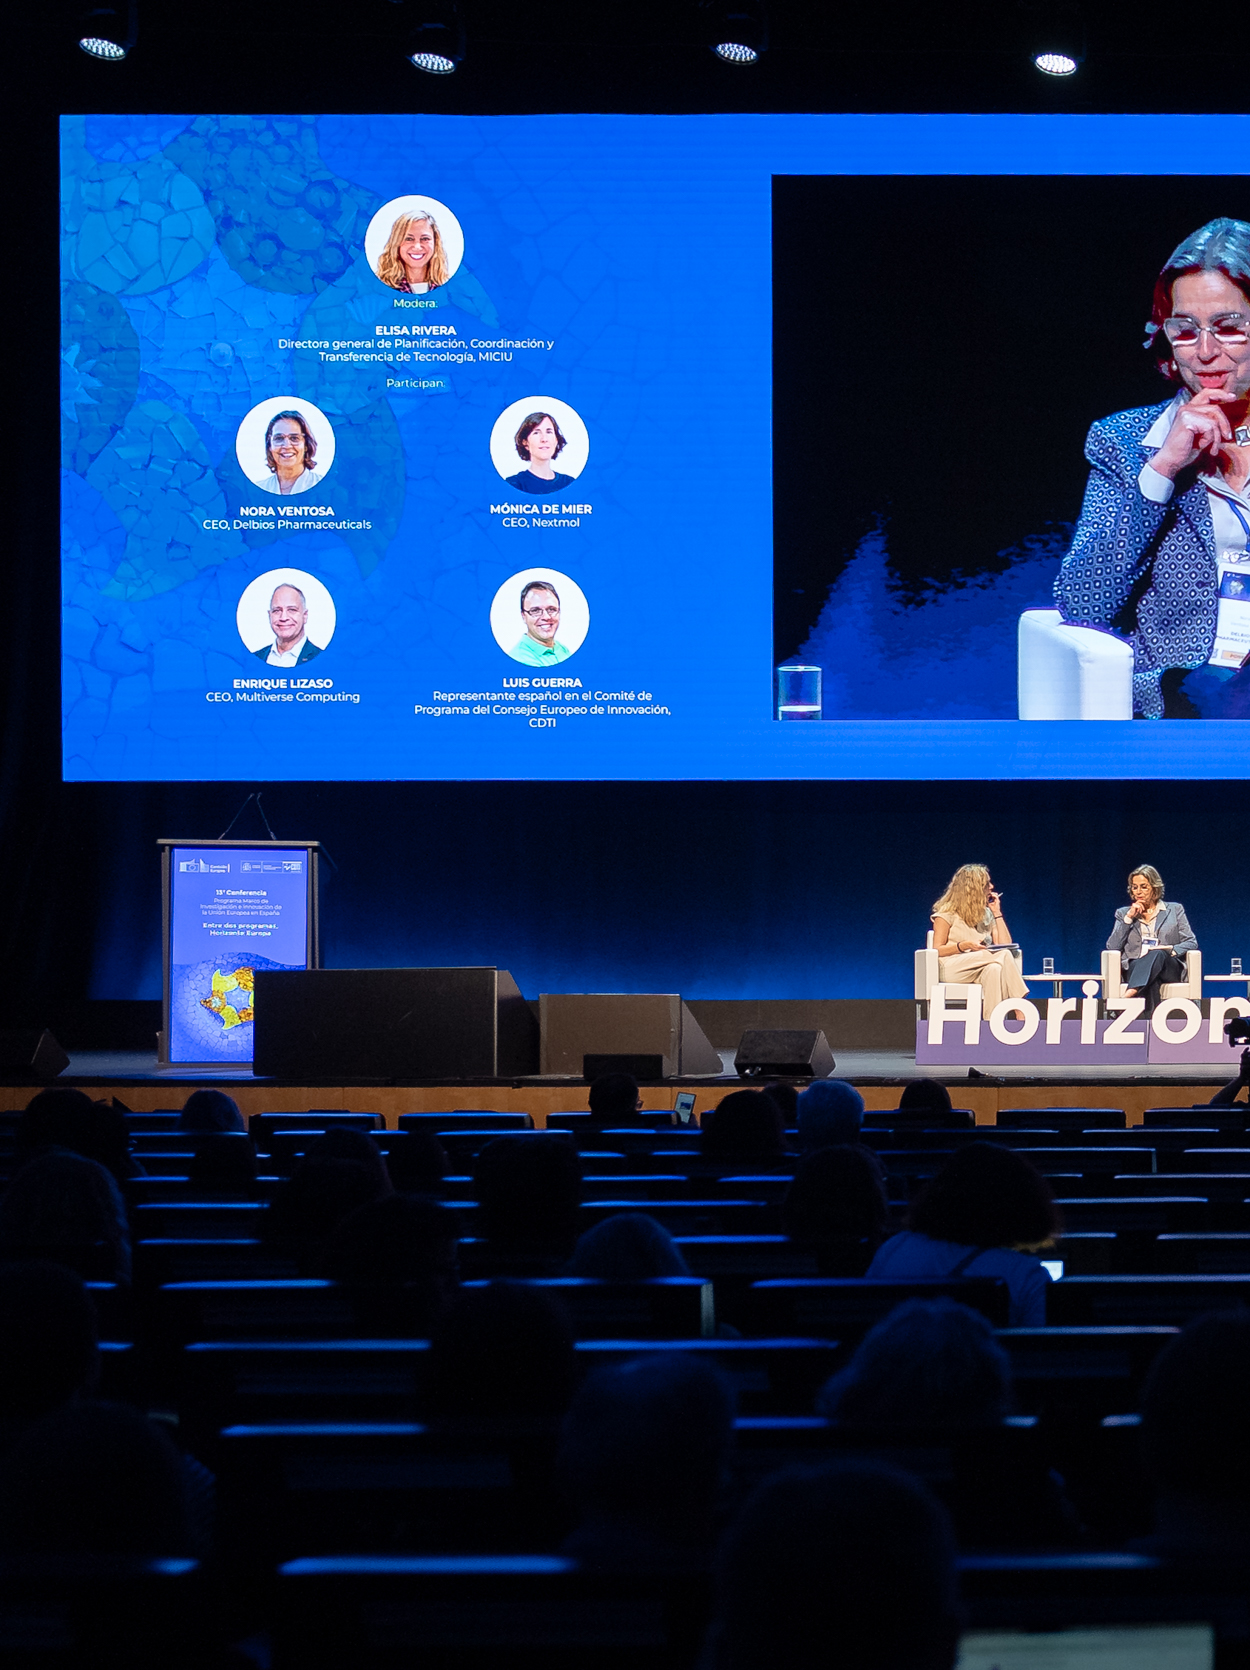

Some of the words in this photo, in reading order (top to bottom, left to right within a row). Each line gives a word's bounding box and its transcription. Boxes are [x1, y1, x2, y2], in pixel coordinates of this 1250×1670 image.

[393, 298, 438, 308] Modera:
[375, 325, 410, 336] ELISA
[411, 325, 457, 336] RIVERA
[278, 338, 330, 349] Directora
[331, 339, 375, 351] general
[376, 338, 392, 349] de
[394, 338, 469, 350] Planificación,
[470, 338, 545, 349] Coordinación
[546, 340, 555, 351] y
[318, 351, 394, 362] Transferencia
[395, 351, 411, 362] de
[412, 351, 477, 364] Tecnología,
[478, 351, 513, 362] MICIU
[240, 506, 276, 517] NORA
[277, 506, 335, 517] VENTOSA
[490, 502, 540, 515] MÓNICA
[542, 504, 560, 514] DE
[561, 504, 593, 515] MIER
[202, 519, 231, 531] CEO,
[233, 519, 276, 530] Delbios
[277, 519, 372, 530] Pharmaceuticals
[502, 517, 530, 529] CEO,
[532, 517, 580, 528] Nextmol
[233, 678, 288, 691] ENRIQUE
[289, 678, 334, 689] LIZASO
[502, 677, 530, 688] LUIS
[531, 677, 583, 688] GUERRA
[205, 691, 234, 703] CEO,
[236, 691, 294, 702] Multiverse
[295, 691, 360, 704] Computing
[433, 690, 517, 703] Representante
[517, 690, 562, 703] español
[564, 692, 580, 701] en
[581, 690, 592, 701] el
[593, 690, 636, 701] Comité
[636, 690, 653, 701] de
[414, 704, 470, 717] Programa
[472, 704, 490, 715] del
[492, 704, 538, 717] Consejo
[540, 704, 588, 717] Europeo
[589, 704, 605, 715] de
[607, 704, 672, 716] Innovación,
[528, 717, 557, 728] CDTI
[226, 889, 267, 897] Conferencia
